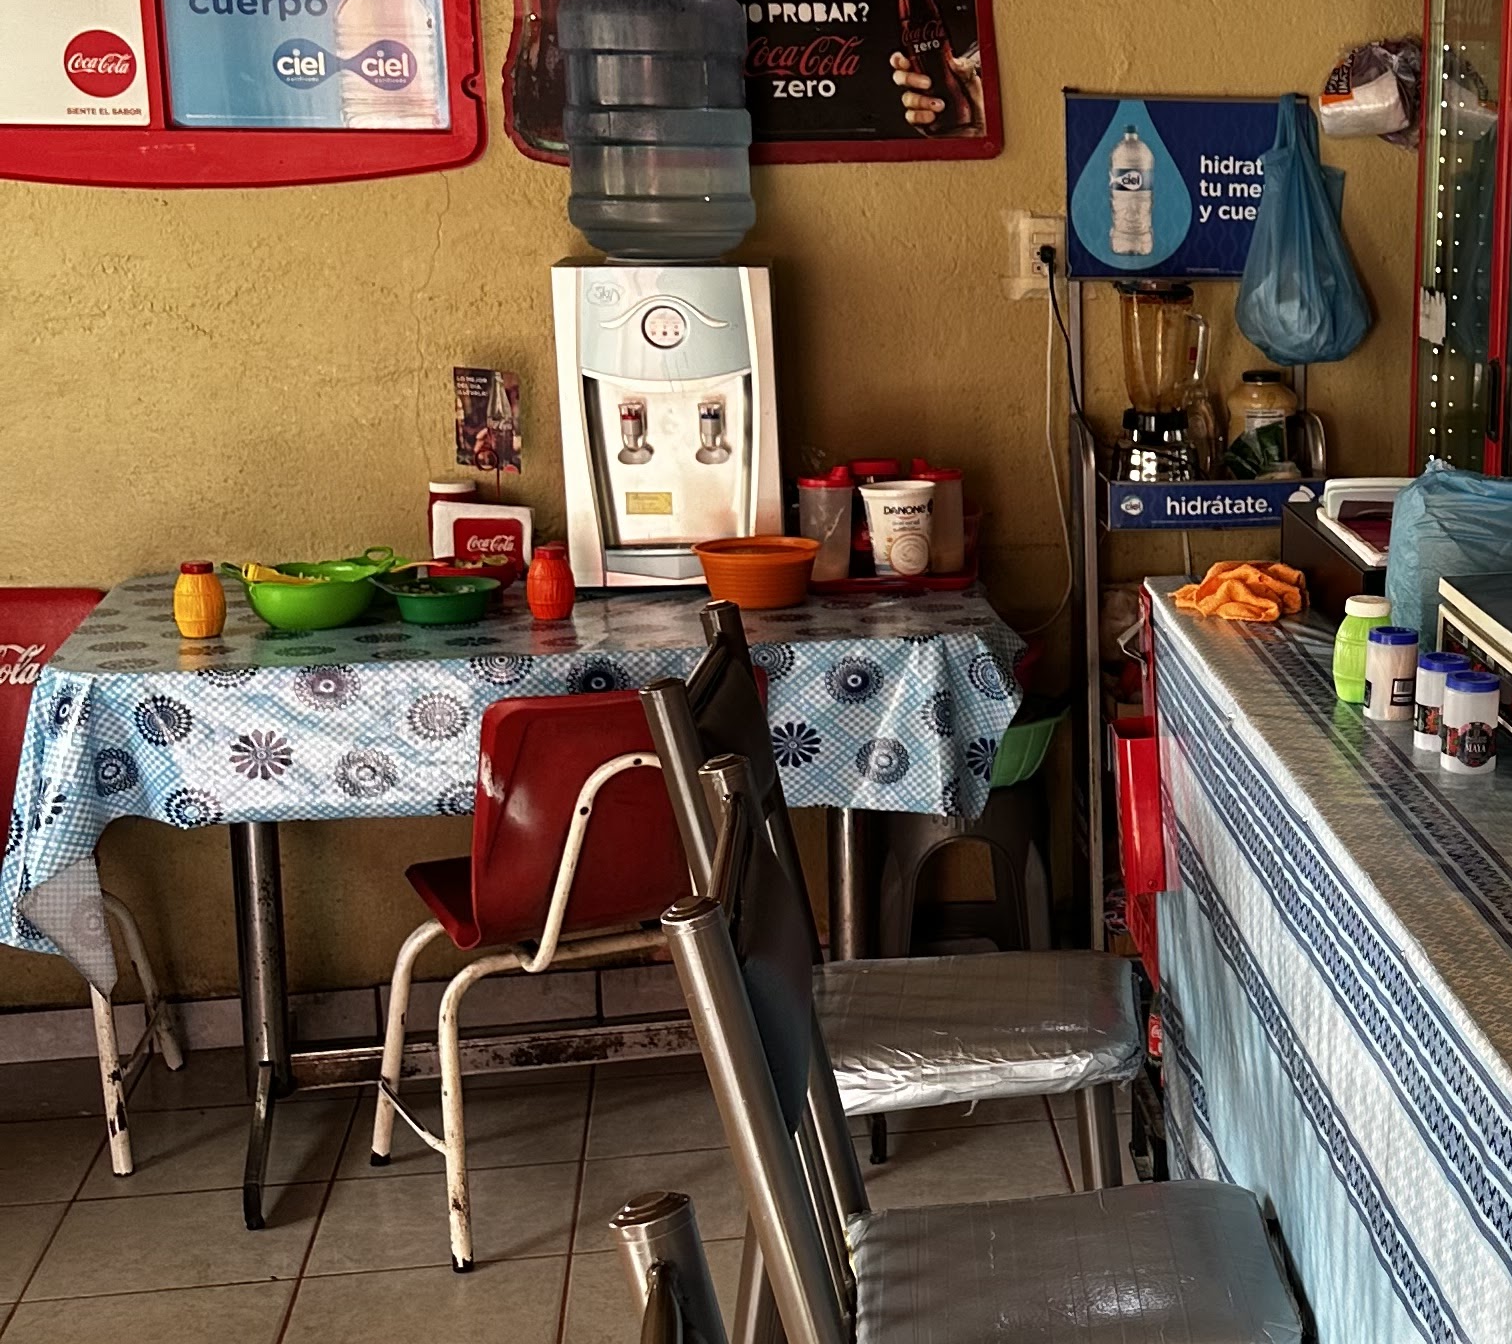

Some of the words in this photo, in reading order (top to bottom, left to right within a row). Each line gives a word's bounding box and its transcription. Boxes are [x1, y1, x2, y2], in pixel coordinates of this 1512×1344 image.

[768, 3, 869, 23] PROBAR?
[913, 39, 940, 54] zero
[68, 52, 131, 75] Coca-Cola
[276, 47, 325, 76] ciel
[361, 48, 409, 78] ciel
[744, 36, 864, 77] Coca-Cola
[773, 79, 836, 98] zero
[1200, 155, 1264, 176] hidrat
[1122, 174, 1140, 187] ciel
[1199, 179, 1221, 197] tu
[1228, 183, 1266, 198] me
[1199, 205, 1212, 223] y
[884, 505, 926, 515] DANONE
[1167, 495, 1272, 516] hidrátate.
[467, 535, 516, 553] Coca-Cola
[1466, 743, 1486, 753] MAYA
